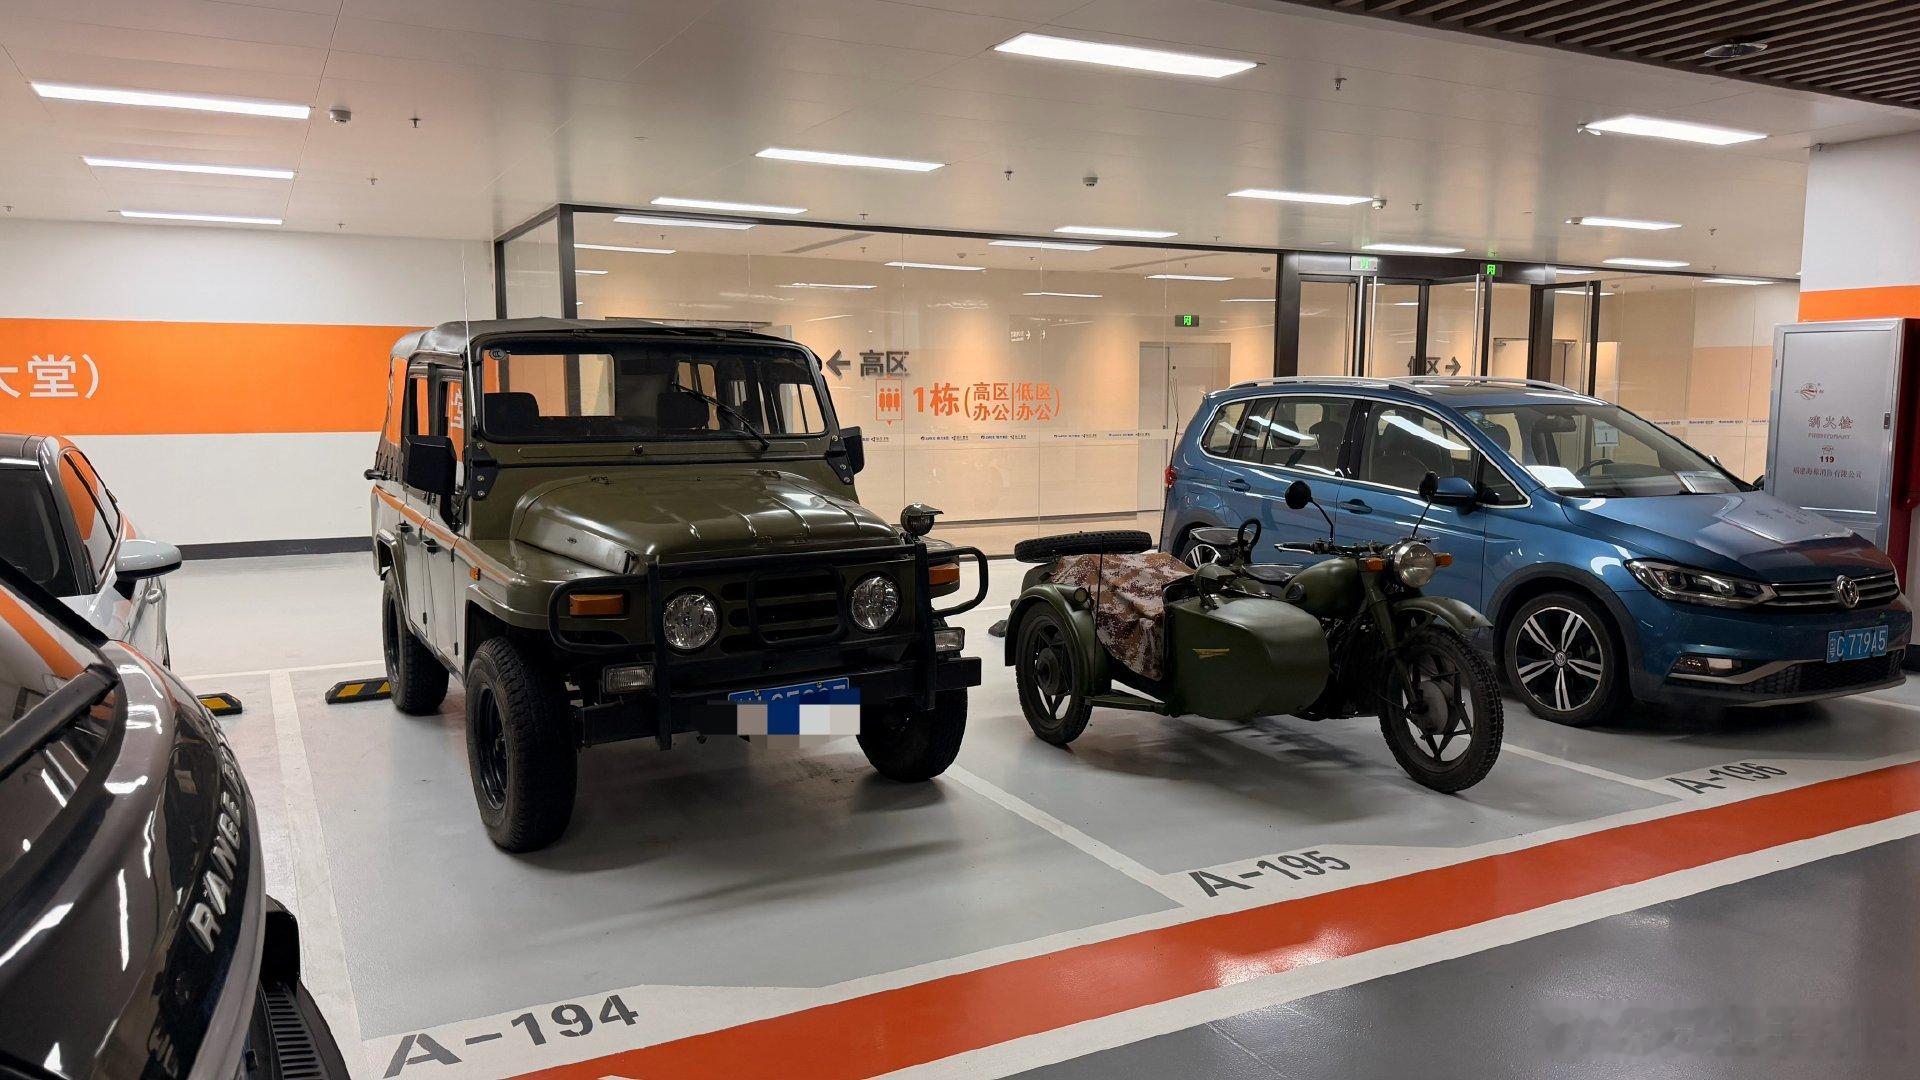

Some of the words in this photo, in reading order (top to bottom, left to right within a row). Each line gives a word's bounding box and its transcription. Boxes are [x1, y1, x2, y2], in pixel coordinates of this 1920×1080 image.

[859, 350, 910, 377] 高区
[913, 382, 960, 417] 1栋
[1820, 455, 1835, 463] 119
[1665, 762, 1788, 794] A-196
[187, 791, 241, 953] RANGE
[1188, 850, 1351, 898] A-195
[383, 994, 640, 1079] A-194
